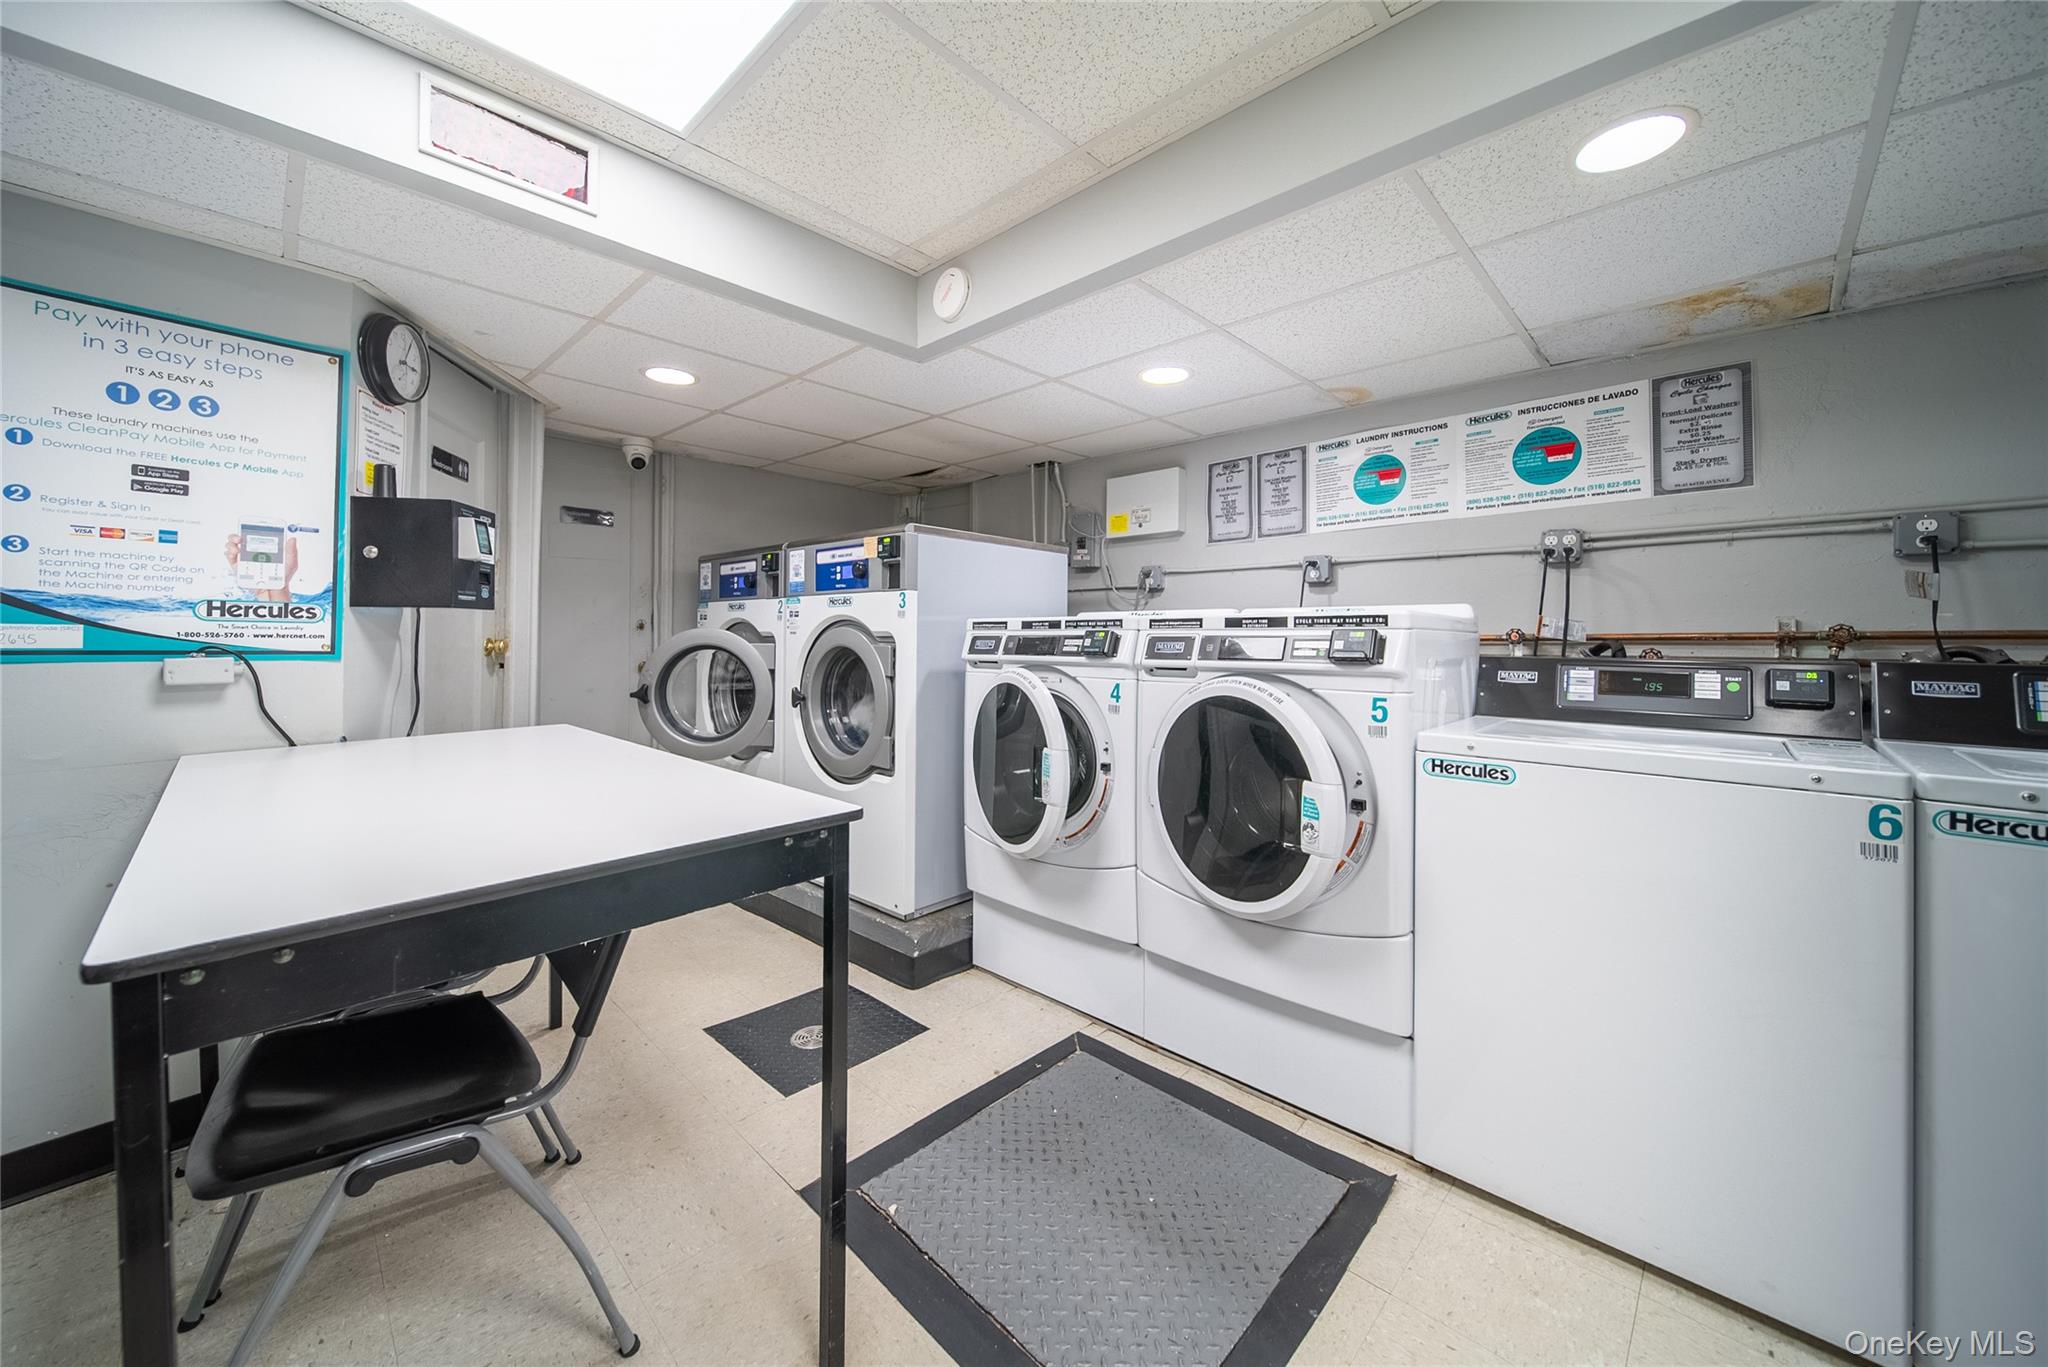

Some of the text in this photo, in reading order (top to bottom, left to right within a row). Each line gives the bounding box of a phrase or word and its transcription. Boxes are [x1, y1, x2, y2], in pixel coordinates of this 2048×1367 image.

[34, 300, 295, 366] Pay with your phone
[82, 332, 263, 380] in 3 easy steps
[125, 365, 214, 389] IT'S AS EASY AS
[1684, 374, 1720, 387] Hercules
[1469, 388, 1639, 425] Hercules INSTRUCCIONES DE LAVADO
[52, 406, 259, 444] These laundry machines use the
[1669, 411, 1732, 425] Normal/Delicate
[1701, 423, 1722, 431] Rinse
[68, 421, 149, 443] CleanPay
[154, 433, 205, 449] Mobile
[209, 442, 235, 454] App
[239, 445, 253, 455] for
[257, 449, 307, 462] Payment
[1319, 422, 1448, 452] Hercules LAUNDRY INSTRUCTIONS
[1677, 438, 1701, 446] Power
[1703, 434, 1725, 442] Wash
[42, 438, 304, 479] Download the FREE Hercules CP Mobile App
[144, 485, 169, 493] Google
[170, 487, 184, 495] Play
[1591, 487, 1641, 497] www.hercnet.com
[40, 494, 151, 512] Register & Sign In
[39, 546, 175, 563] Start the machine by
[38, 558, 100, 570] scanning
[104, 561, 125, 570] the
[128, 562, 148, 571] QR
[151, 563, 186, 573] Code
[38, 568, 60, 577] the
[65, 570, 123, 580] Machine
[143, 574, 193, 585] entering
[38, 579, 175, 593] the Machine number
[777, 600, 784, 614] 2
[829, 596, 852, 606] Hercules
[899, 592, 906, 609] 3
[206, 600, 318, 620] Hercules
[1296, 617, 1312, 625] CYCLE
[176, 631, 326, 640] 1-800-526-5760 www.hercnet.com
[1500, 671, 1536, 680] MAYTAG
[1110, 682, 1121, 703] 4
[1243, 681, 1257, 689] WHEN
[1258, 686, 1268, 694] NOT
[1272, 694, 1284, 705] USE
[1916, 681, 1976, 693] MAYTAG
[1371, 697, 1389, 724] 5
[1431, 758, 1510, 781] Hercules
[1868, 803, 1903, 841] 6
[1950, 810, 2048, 842] Hercu
